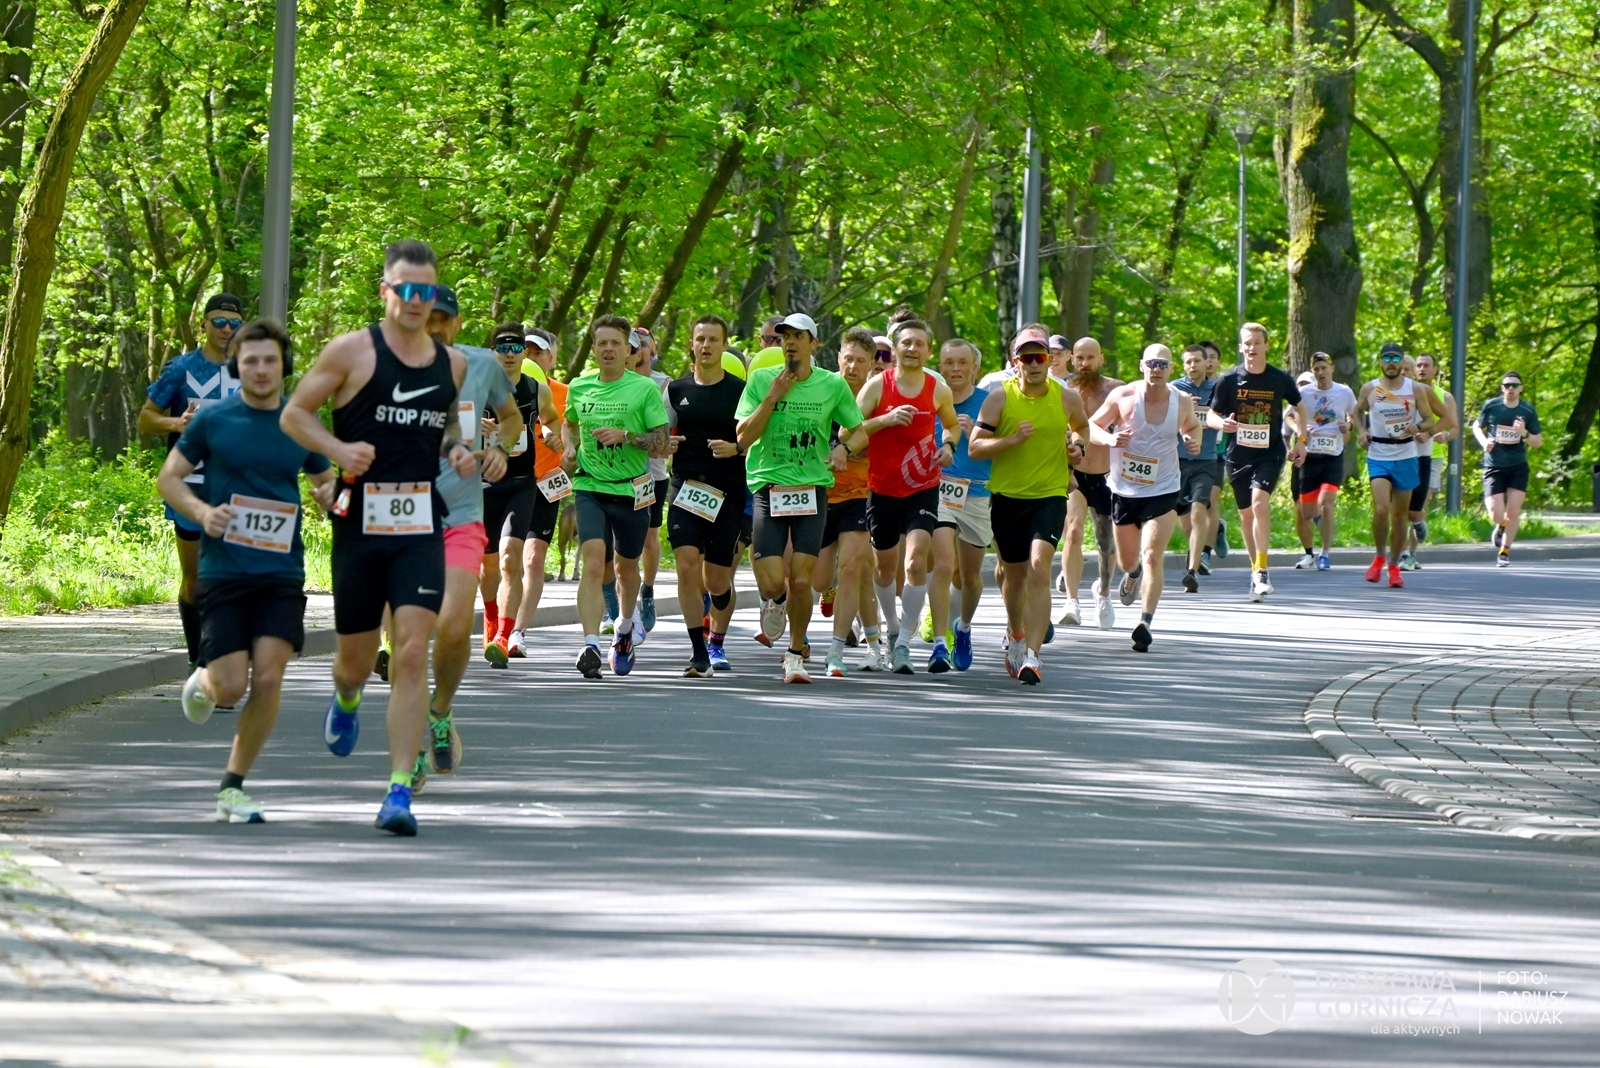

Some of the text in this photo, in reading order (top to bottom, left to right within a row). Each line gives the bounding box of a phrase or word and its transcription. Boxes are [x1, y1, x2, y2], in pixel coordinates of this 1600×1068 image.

[1237, 388, 1248, 398] 17
[581, 402, 595, 413] 17
[773, 400, 788, 412] 17
[374, 404, 418, 425] STOP
[1243, 430, 1267, 440] 1280
[1317, 438, 1334, 447] 1531
[1128, 461, 1151, 475] 248
[547, 474, 568, 490] 458
[939, 482, 964, 498] 490
[687, 489, 718, 510] 1520
[782, 492, 810, 506] 238
[389, 498, 415, 517] 80
[245, 512, 287, 533] 1137
